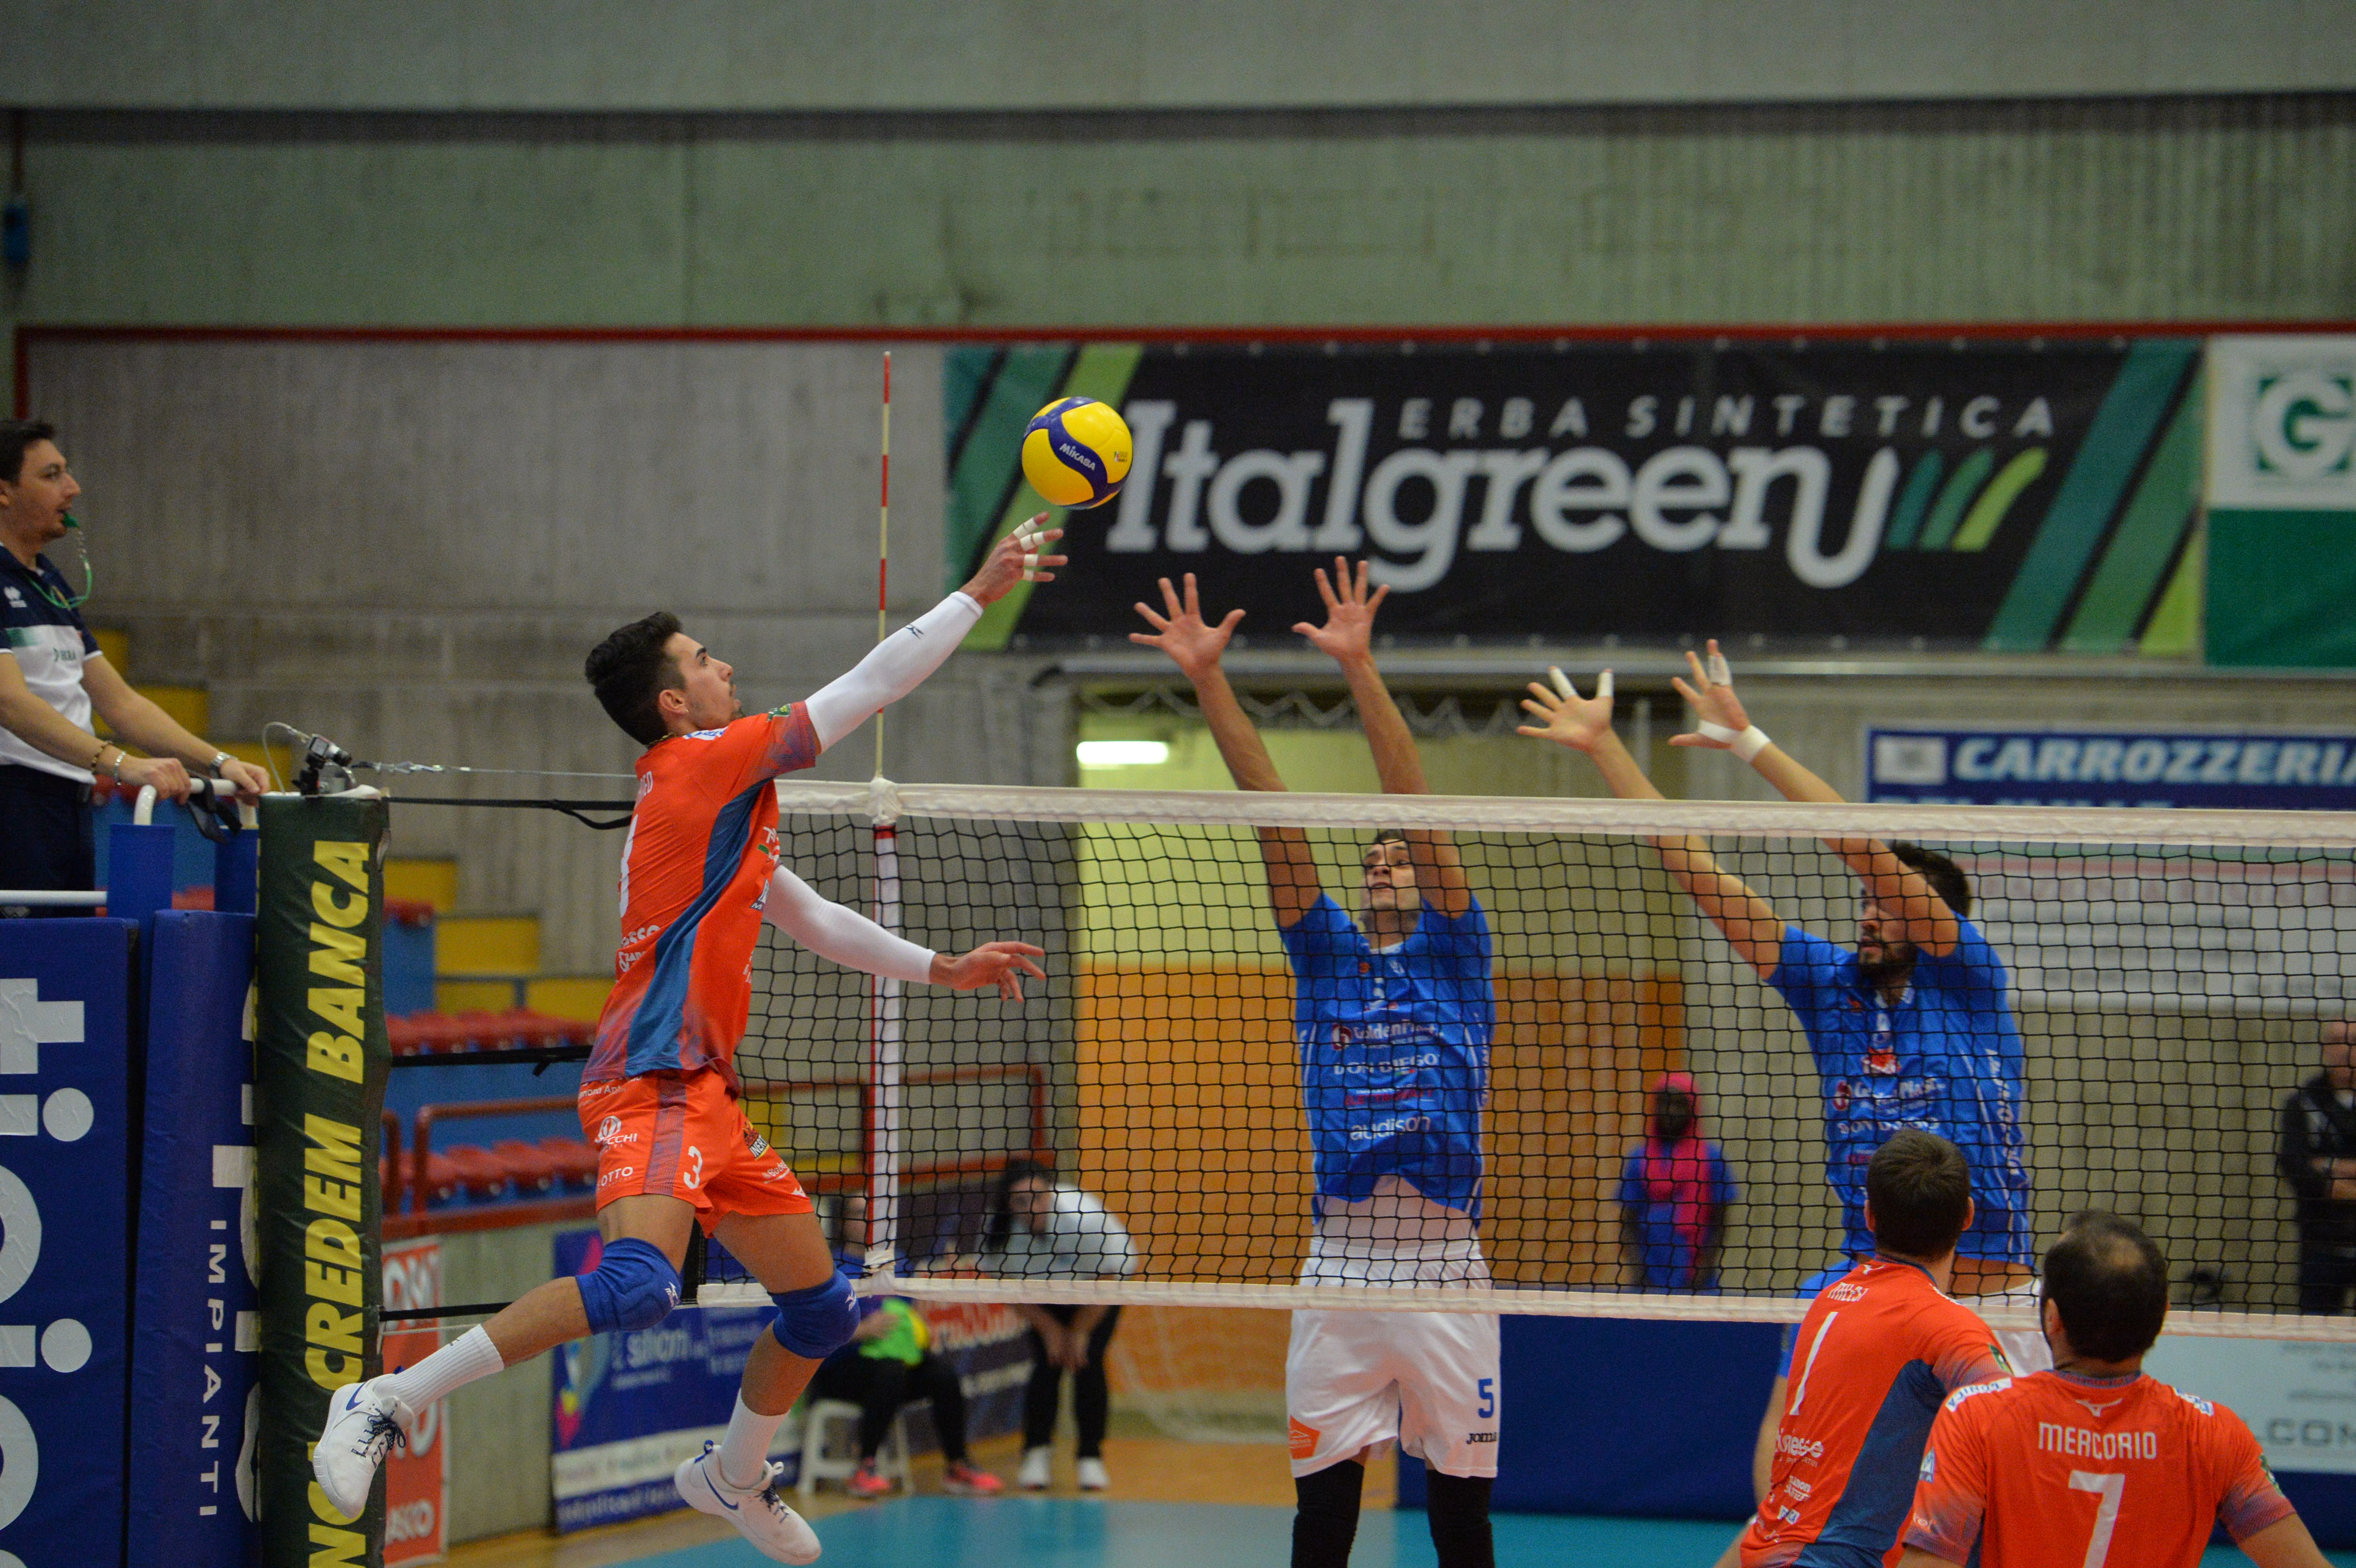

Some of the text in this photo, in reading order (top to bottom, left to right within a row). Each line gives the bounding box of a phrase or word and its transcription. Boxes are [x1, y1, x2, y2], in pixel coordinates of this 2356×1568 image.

[1399, 394, 2055, 440] ERBA SINTETICA
[1105, 398, 1901, 592] Italgreen
[306, 840, 370, 1084] BANCA
[599, 1166, 633, 1187] OTTO
[683, 1145, 703, 1189] 3
[304, 1113, 364, 1392] CREDEM
[1827, 1282, 1869, 1302] MILESI
[199, 1219, 227, 1517] IMPIANTI
[1478, 1378, 1494, 1418] 5
[1789, 1311, 1839, 1416] 1
[2038, 1421, 2157, 1460] MERCORIO
[2068, 1470, 2126, 1568] 7
